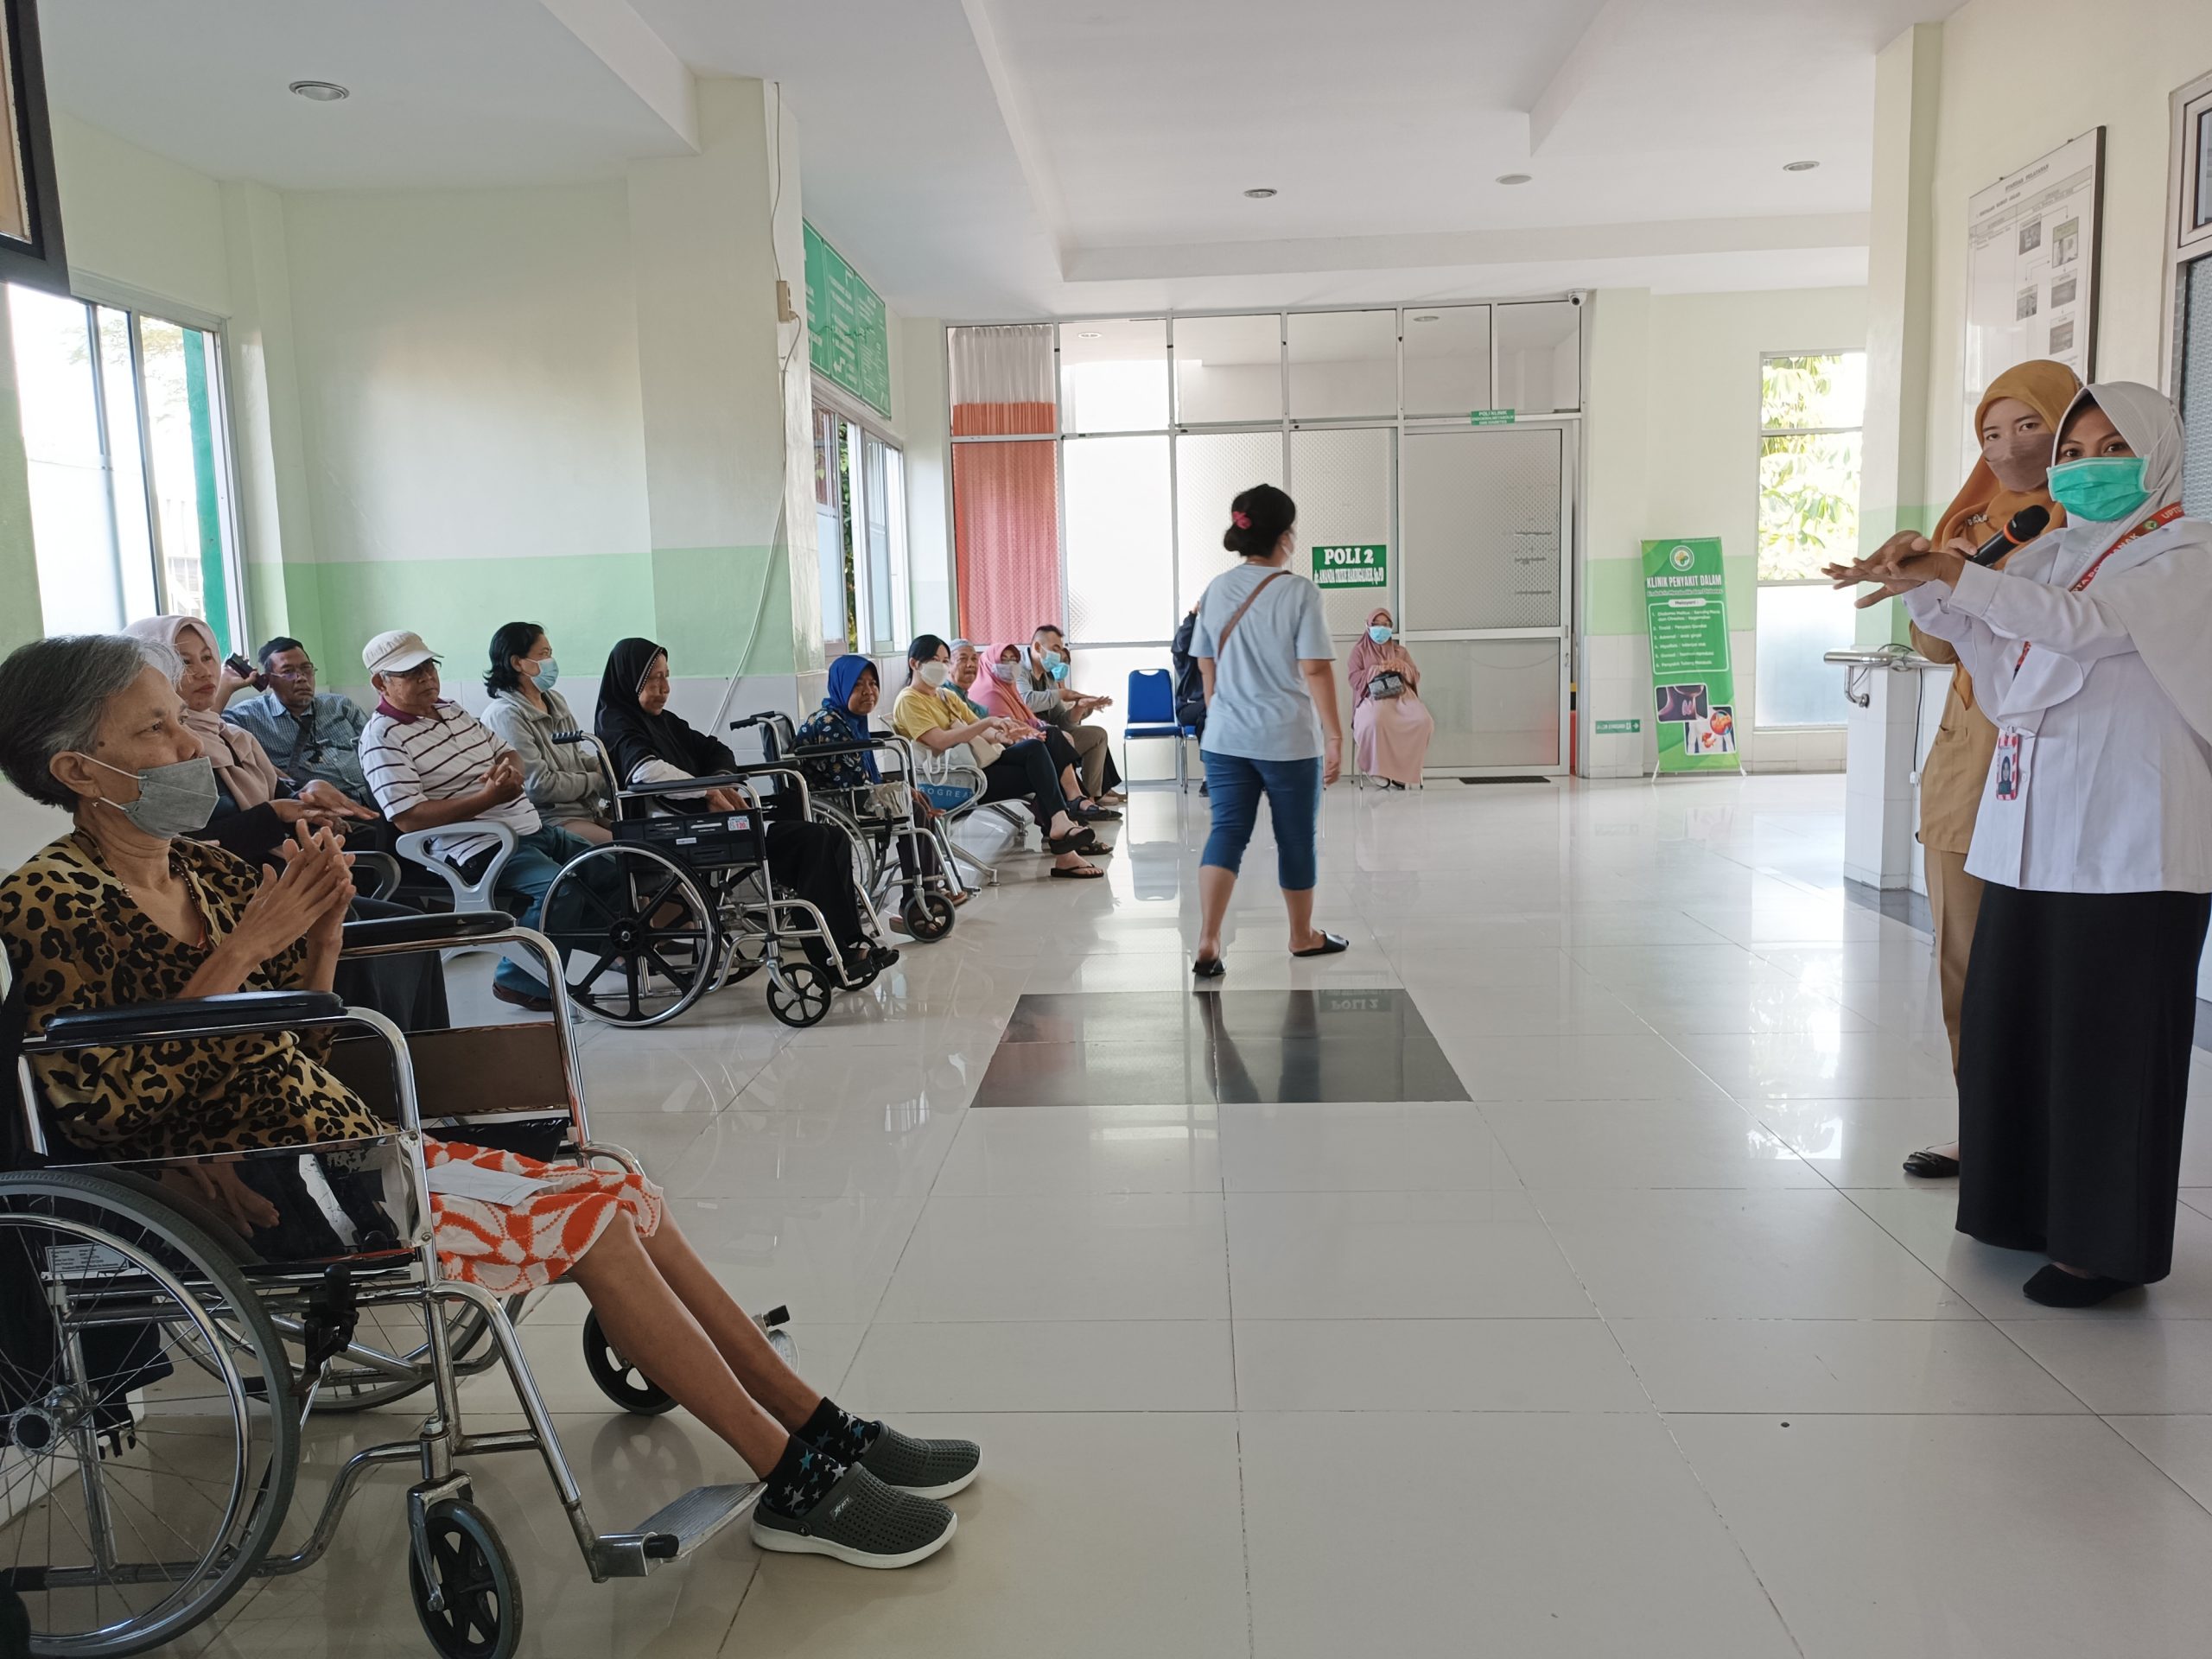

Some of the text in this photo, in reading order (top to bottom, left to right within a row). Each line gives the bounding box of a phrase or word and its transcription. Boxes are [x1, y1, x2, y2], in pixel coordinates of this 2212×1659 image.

[1324, 548, 1374, 565] POLI 2
[1647, 575, 1722, 588] KLINIK PENYAKIT DALAM
